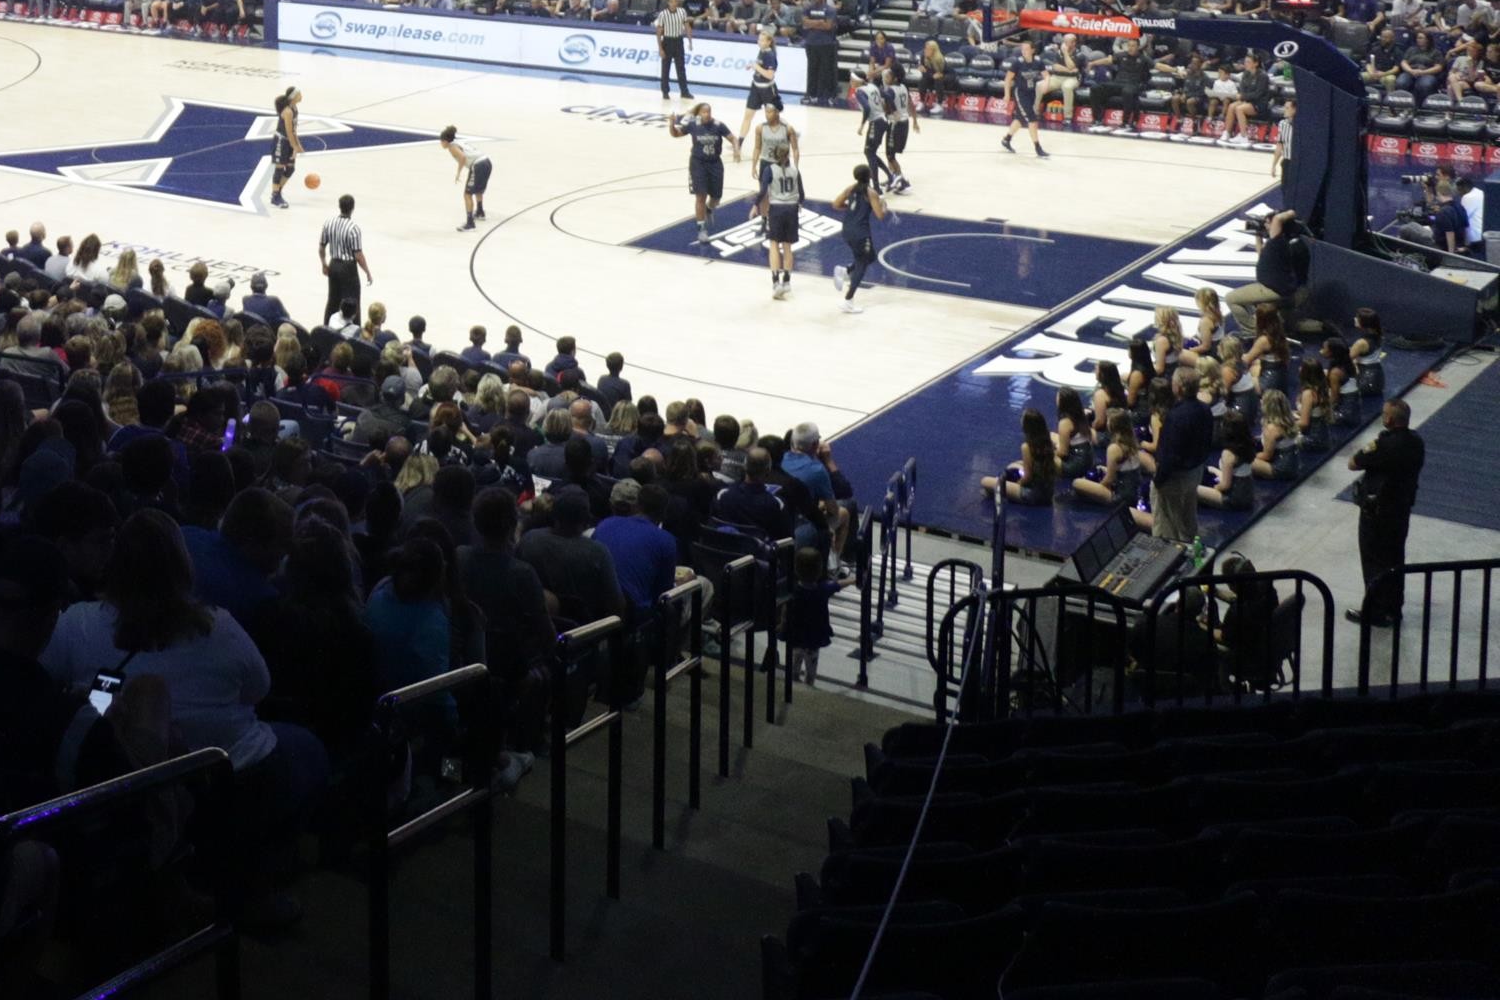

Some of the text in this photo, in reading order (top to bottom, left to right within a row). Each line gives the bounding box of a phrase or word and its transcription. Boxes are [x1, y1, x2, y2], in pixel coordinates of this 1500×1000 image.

[1131, 17, 1176, 31] SPALDING
[344, 18, 485, 47] swapalease.com
[779, 177, 794, 193] 10
